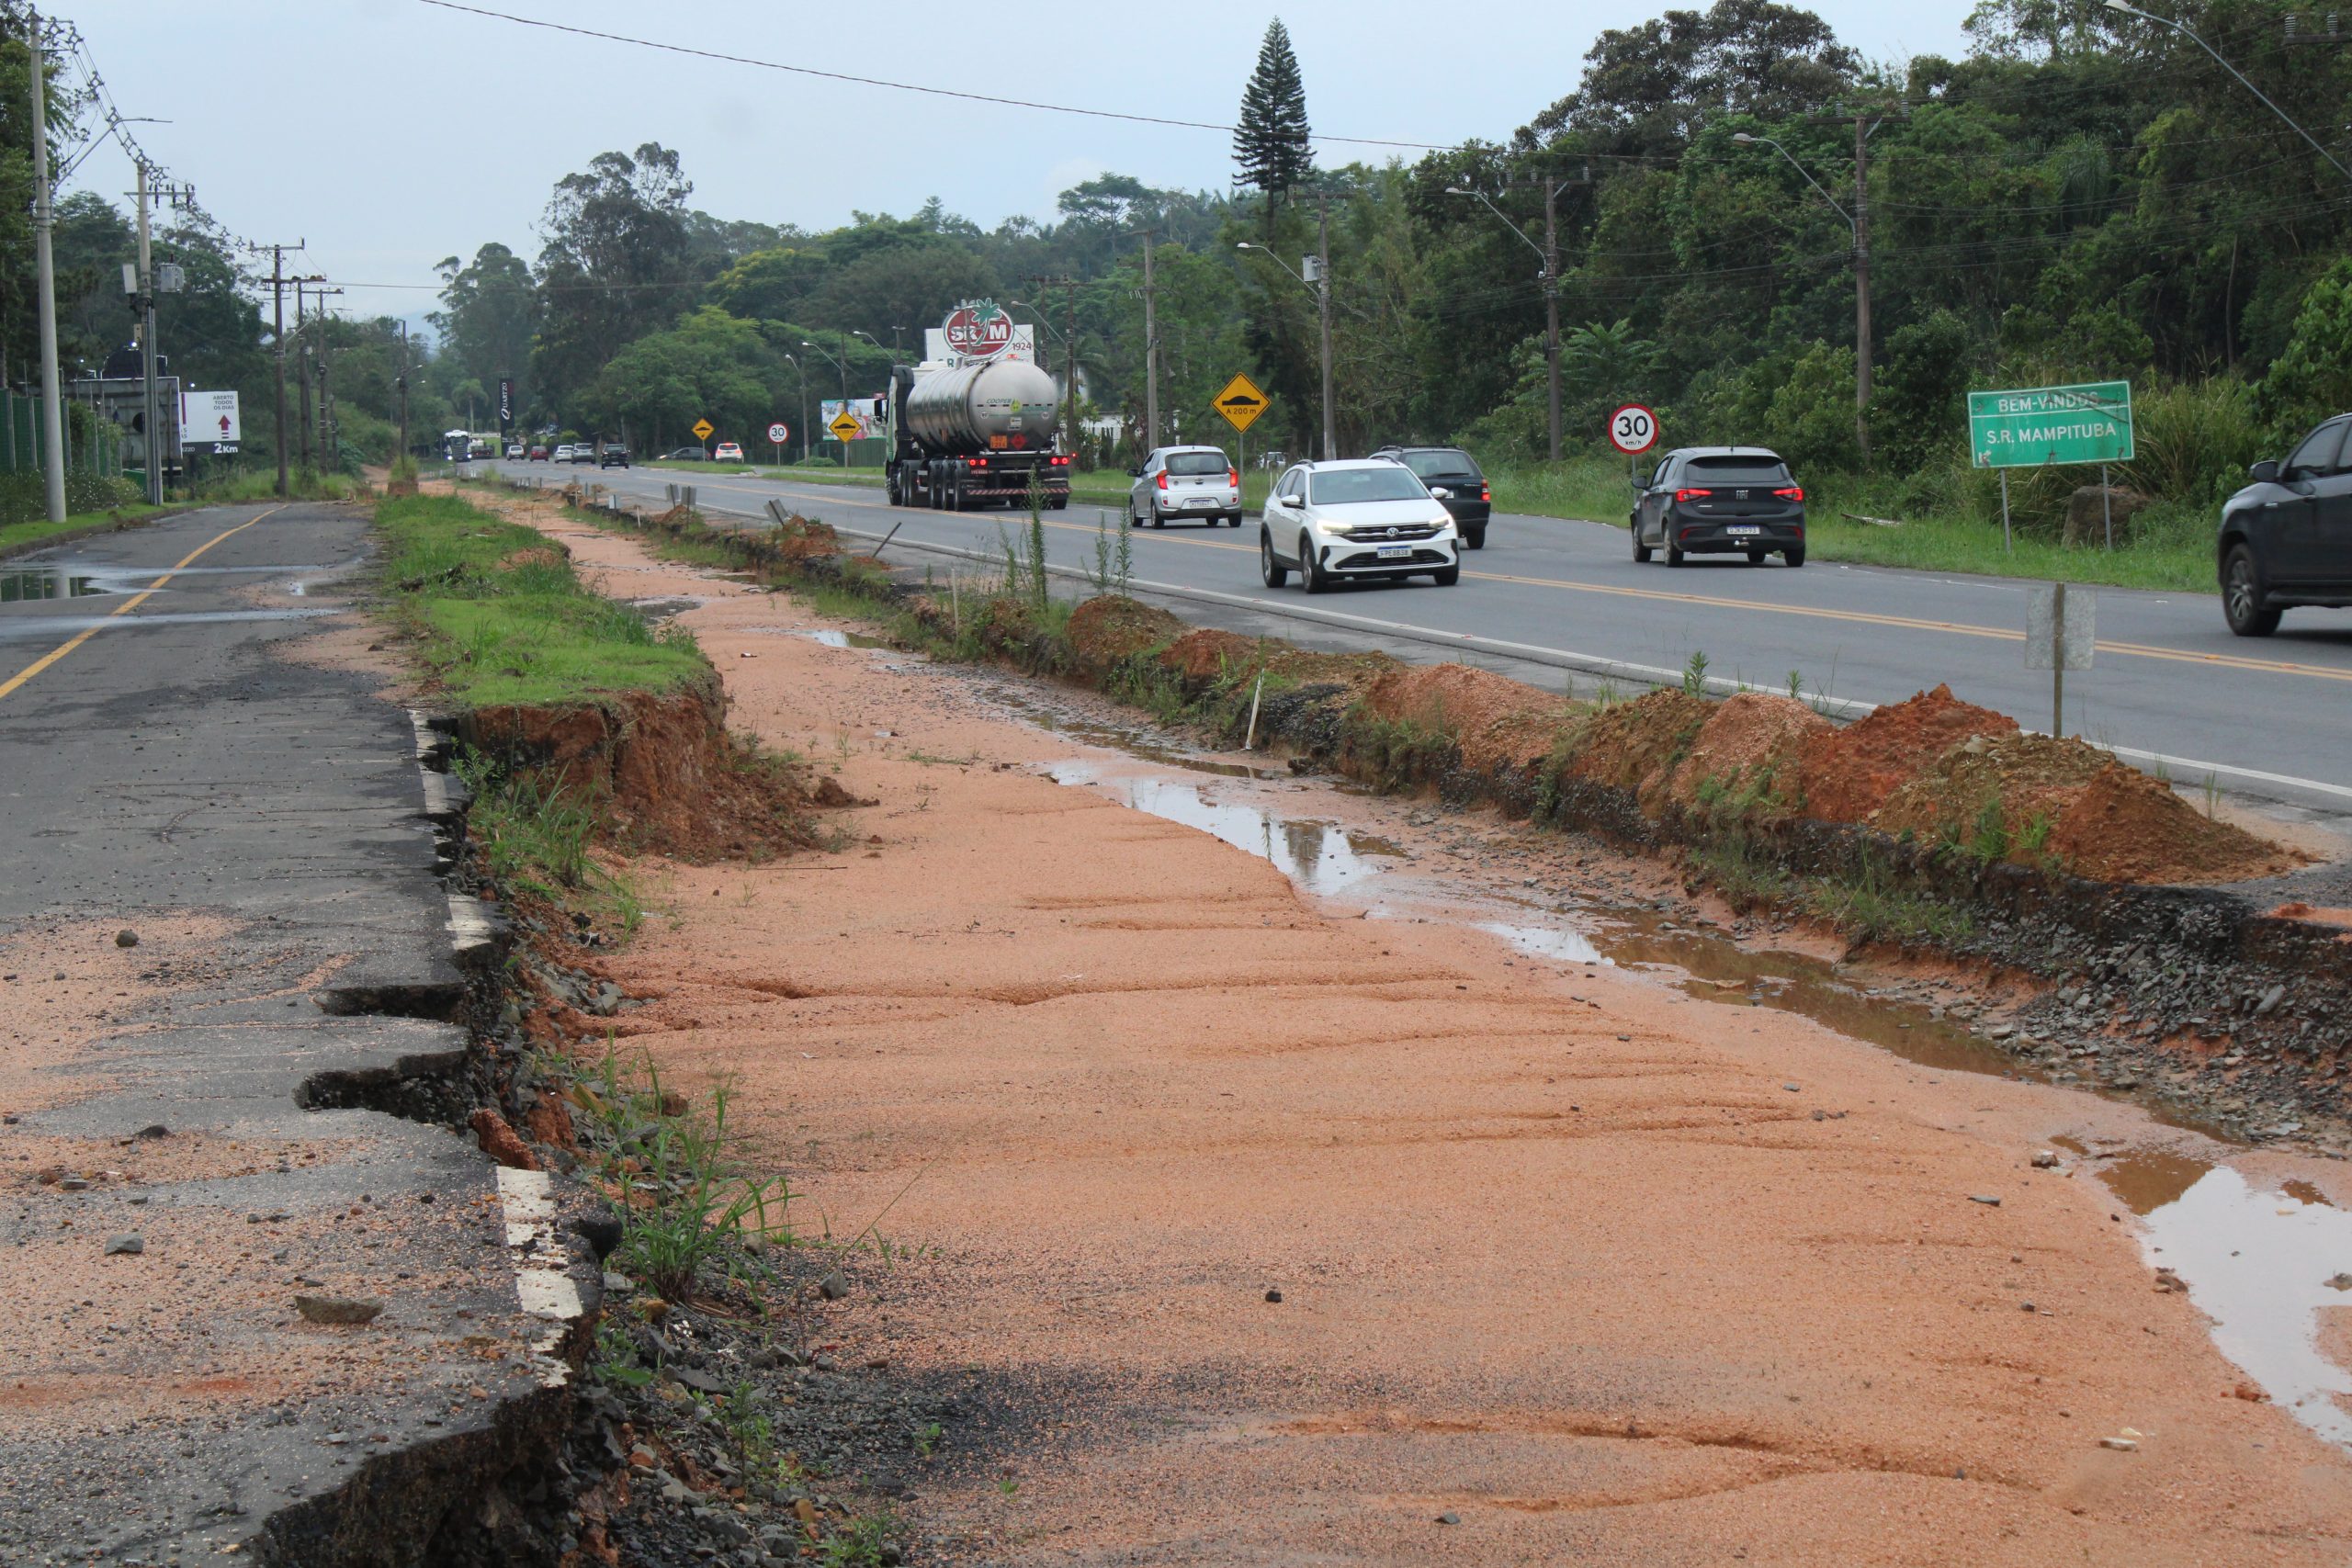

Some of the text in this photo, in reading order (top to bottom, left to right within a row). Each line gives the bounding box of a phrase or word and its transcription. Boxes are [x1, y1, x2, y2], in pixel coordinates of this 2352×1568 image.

[1012, 342, 1032, 351] 1924
[1998, 391, 2100, 412] BEM-VINDOS
[1226, 407, 1232, 415] A
[1233, 407, 1249, 415] 200
[1618, 415, 1649, 437] 30
[771, 427, 786, 437] 30
[1986, 422, 2117, 445] S.R. MAMPITUBA
[1736, 490, 1749, 501] FIAT
